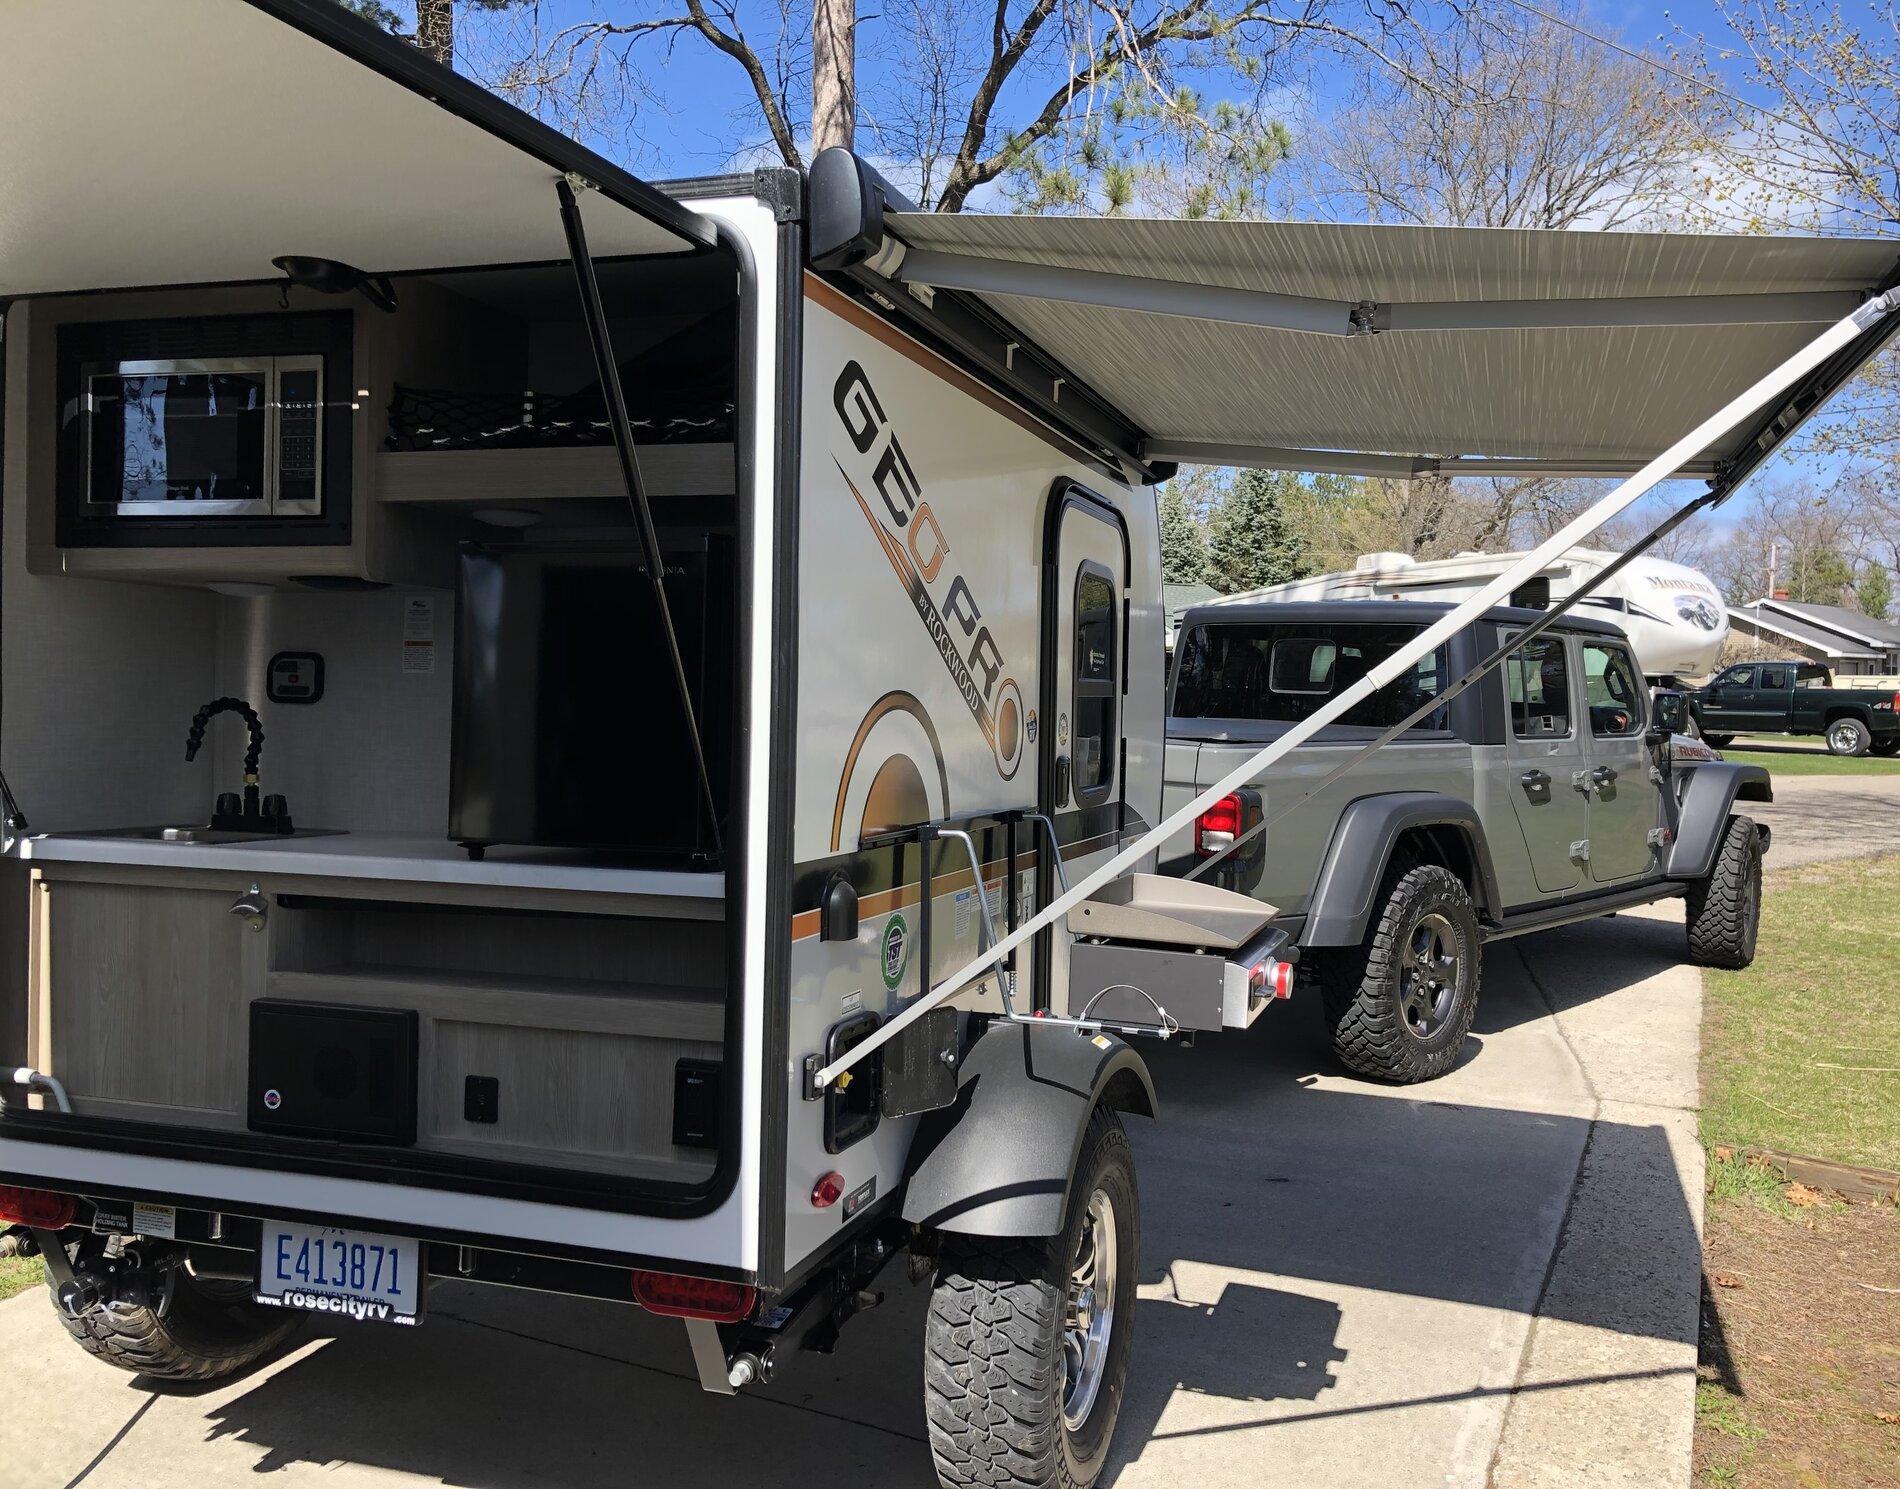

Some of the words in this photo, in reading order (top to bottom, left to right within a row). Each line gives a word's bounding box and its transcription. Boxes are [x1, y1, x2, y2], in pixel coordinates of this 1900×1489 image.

[834, 359, 951, 584] GEO
[1644, 575, 1714, 596] Montana
[918, 592, 930, 613] BY
[925, 606, 980, 711] ROCKWOOD
[276, 1233, 401, 1295] E413871
[284, 1290, 389, 1320] rosecityrv
